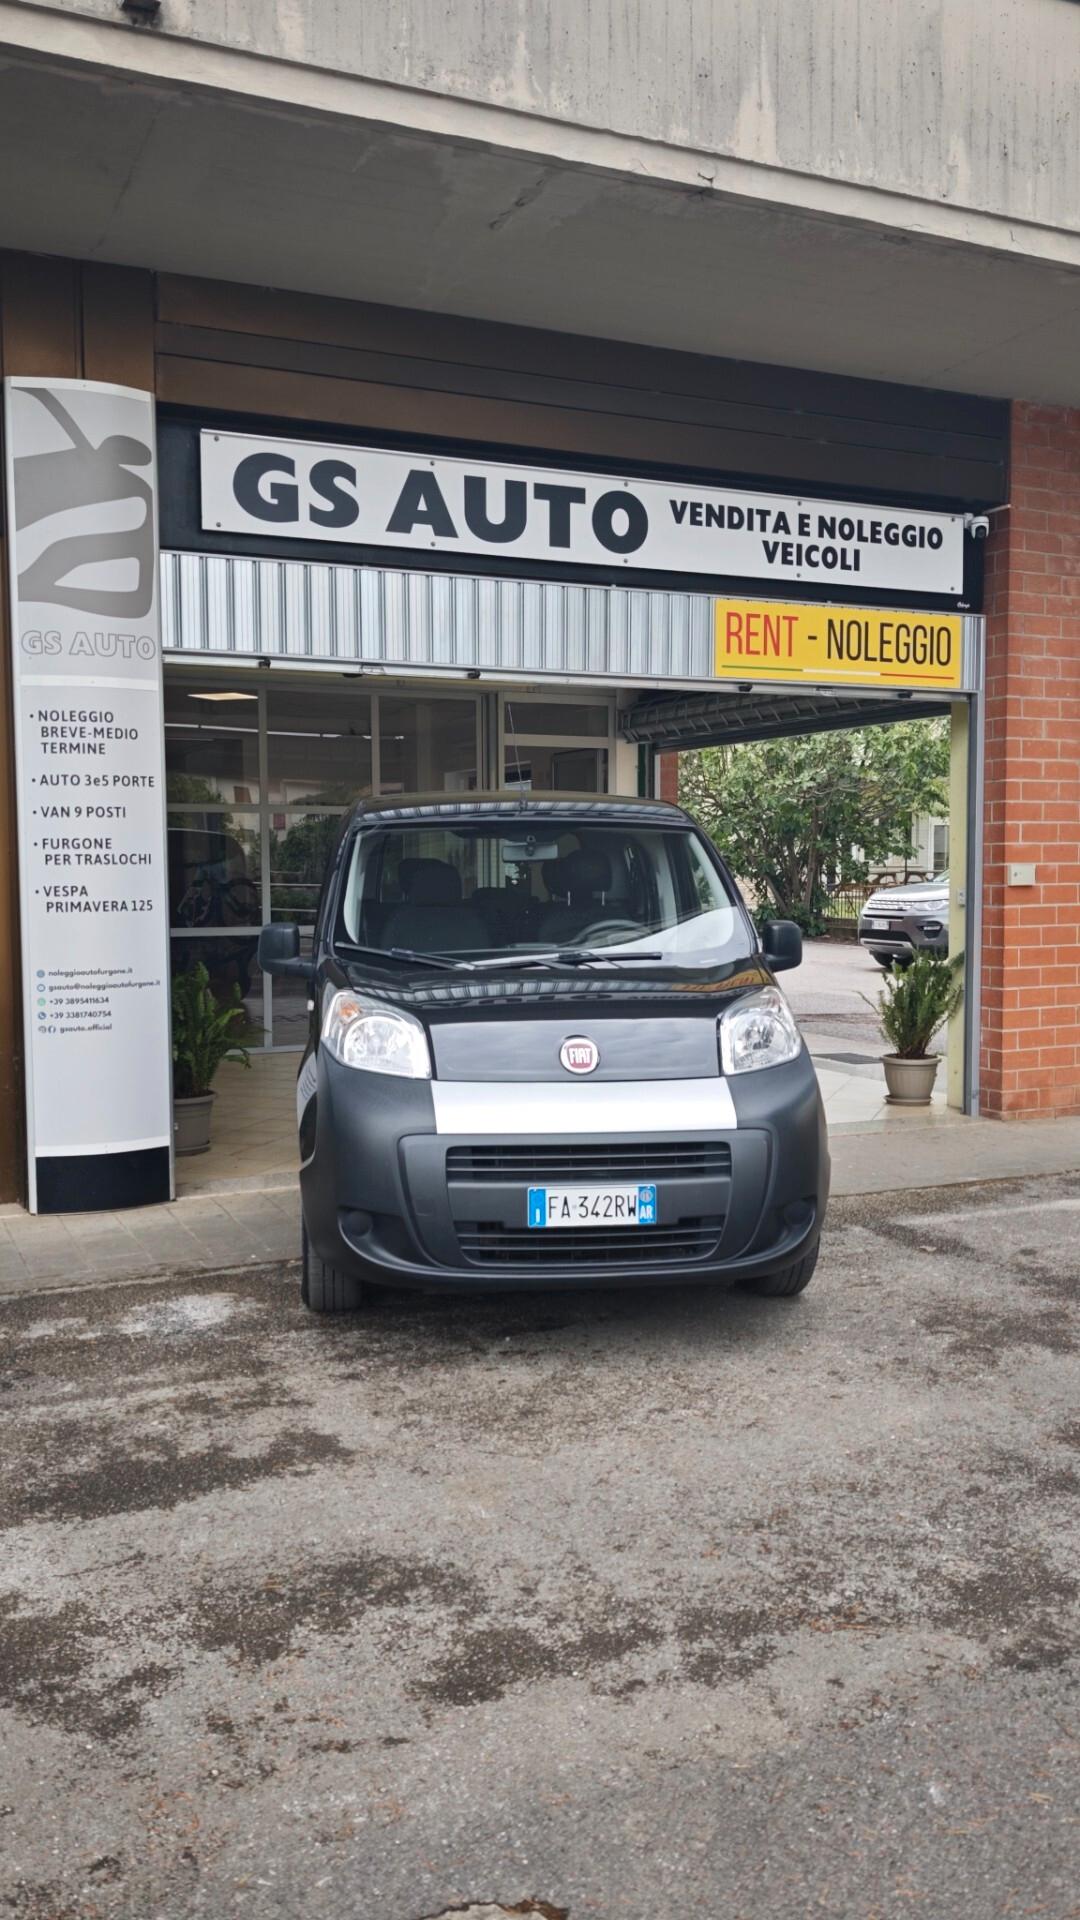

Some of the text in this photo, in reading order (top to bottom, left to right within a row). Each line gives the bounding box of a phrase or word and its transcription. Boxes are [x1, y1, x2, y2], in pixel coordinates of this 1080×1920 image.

[232, 452, 649, 555] GS AUTO
[669, 499, 943, 550] VENDITA E NOLEGGIO
[762, 540, 861, 572] VEICOLI
[21, 630, 156, 660] GS AUTO
[725, 611, 799, 657] RENT
[827, 618, 952, 666] NOLEGGIO
[37, 710, 114, 723] NOLEGGIO
[40, 726, 139, 741] BREVE-MEDIO
[40, 742, 106, 755] TERMINE
[39, 774, 81, 787] AUTO
[112, 775, 155, 788] PORTE
[40, 806, 126, 818] VAN 9 POSTI
[41, 837, 112, 850] FURGONE
[44, 853, 152, 866] PER TRASLOCHI
[42, 885, 89, 897] VESPA
[45, 899, 153, 914] PRIMAVERA 125
[49, 998, 63, 1006] +39
[49, 1012, 64, 1020] +39
[569, 1047, 591, 1064] FIAT
[640, 1205, 653, 1219] AR
